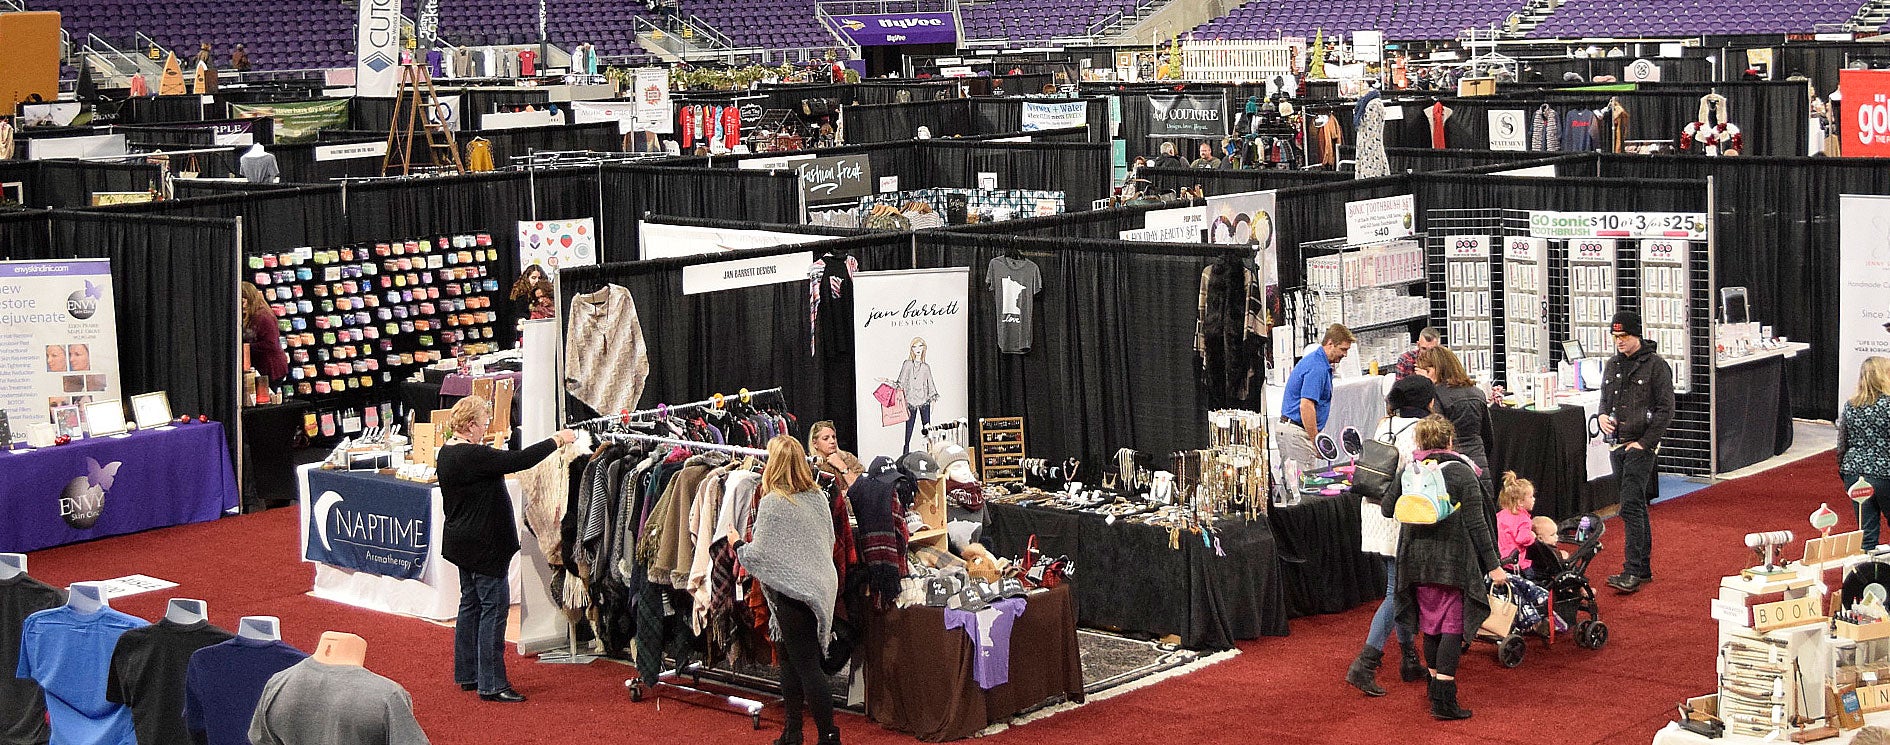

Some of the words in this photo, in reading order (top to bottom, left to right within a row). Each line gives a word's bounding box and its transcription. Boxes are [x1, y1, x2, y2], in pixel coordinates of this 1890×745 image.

[1170, 108, 1218, 120] COUTURE
[802, 162, 835, 188] Fashion
[836, 160, 864, 186] Freak
[1532, 214, 1549, 226] GO
[1552, 216, 1590, 226] sonic
[1591, 215, 1619, 230] $10
[1636, 215, 1646, 230] 3
[1664, 215, 1694, 230] $25
[1160, 228, 1185, 241] BEAUTY
[1186, 225, 1198, 240] SET
[1374, 226, 1389, 236] $40
[1531, 226, 1590, 236] TOOTHBRUSH
[14, 264, 68, 274] envyskinclinic.com
[724, 270, 734, 279] JAN
[734, 268, 755, 278] BARRETT
[756, 265, 777, 276] DESIGNS
[68, 300, 96, 311] ENVY
[0, 312, 66, 326] ejuvenate
[864, 308, 900, 328] jan
[902, 300, 960, 318] barrett
[1002, 314, 1020, 323] love
[1862, 310, 1884, 318] Since
[891, 319, 934, 327] DESIGNS
[58, 492, 105, 516] ENVY
[72, 512, 85, 520] Skin
[336, 507, 428, 548] NAPTIME
[366, 550, 412, 570] Aromatherapy
[1759, 601, 1816, 624] BOOK
